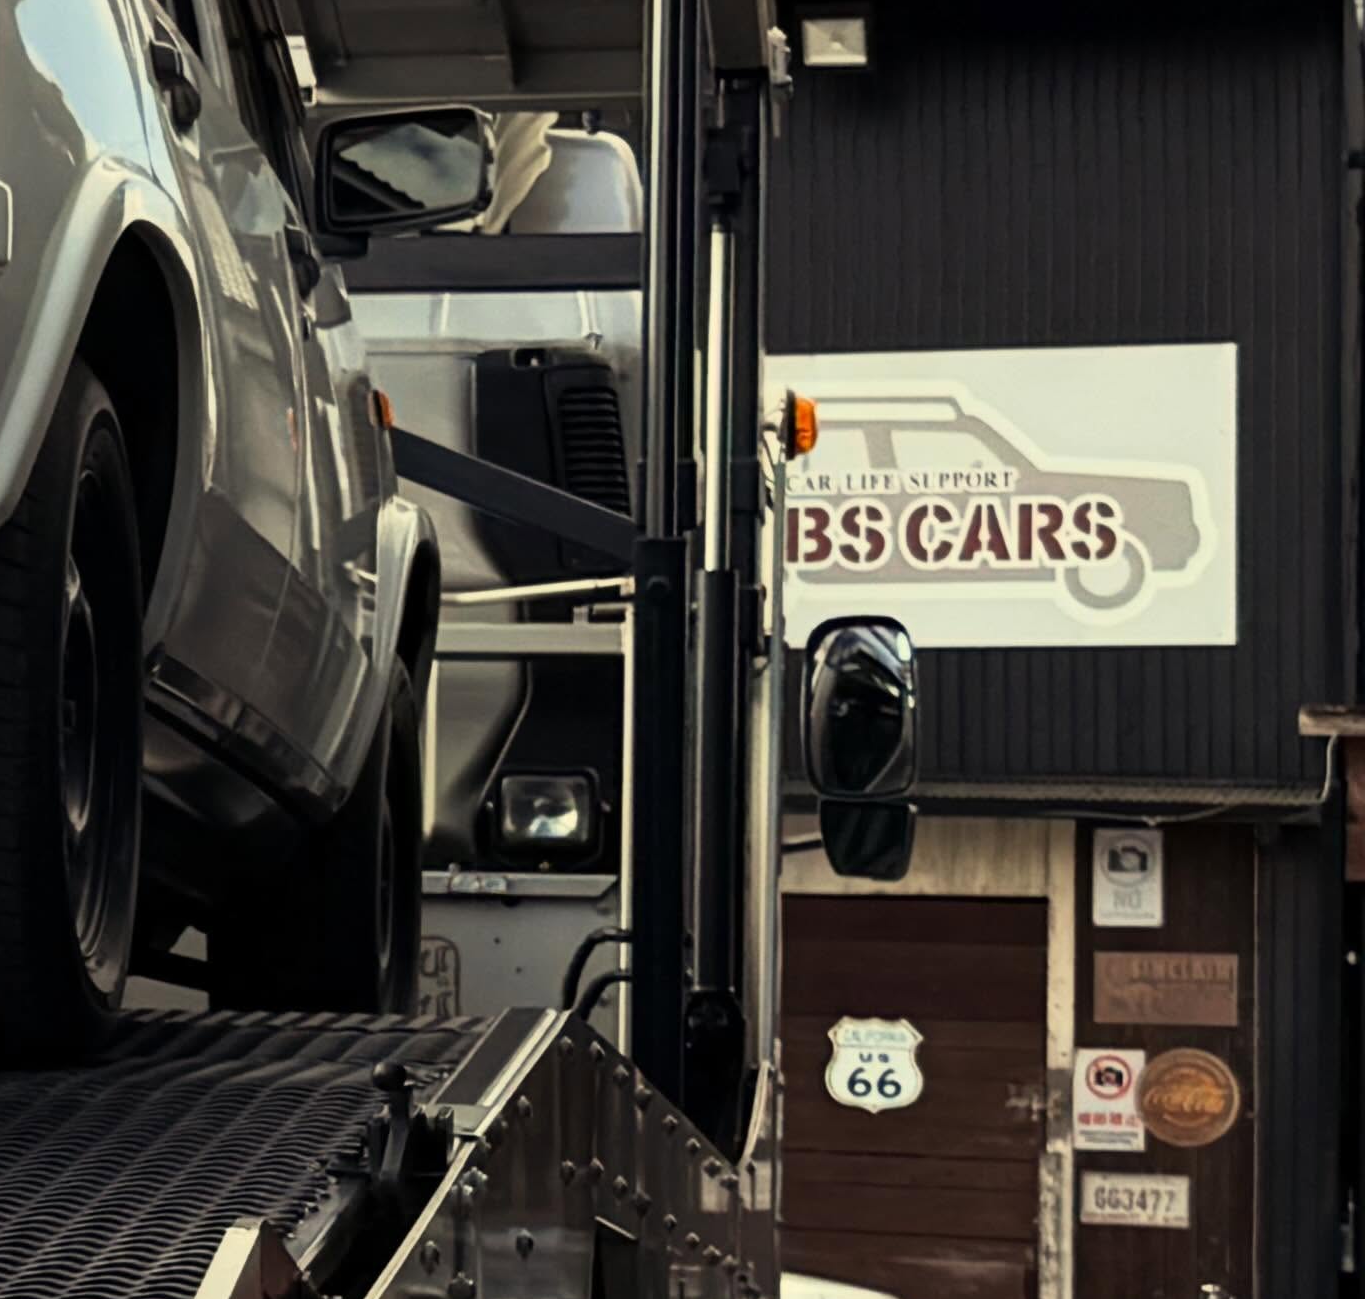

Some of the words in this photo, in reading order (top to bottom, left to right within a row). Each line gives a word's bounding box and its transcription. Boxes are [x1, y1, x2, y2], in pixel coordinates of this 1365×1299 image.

[786, 474, 831, 491] CAR
[846, 472, 893, 490] LIFE
[909, 470, 1013, 491] SUPPORT
[786, 504, 886, 564] BS
[905, 501, 1118, 564] CARS
[847, 1067, 902, 1098] 66
